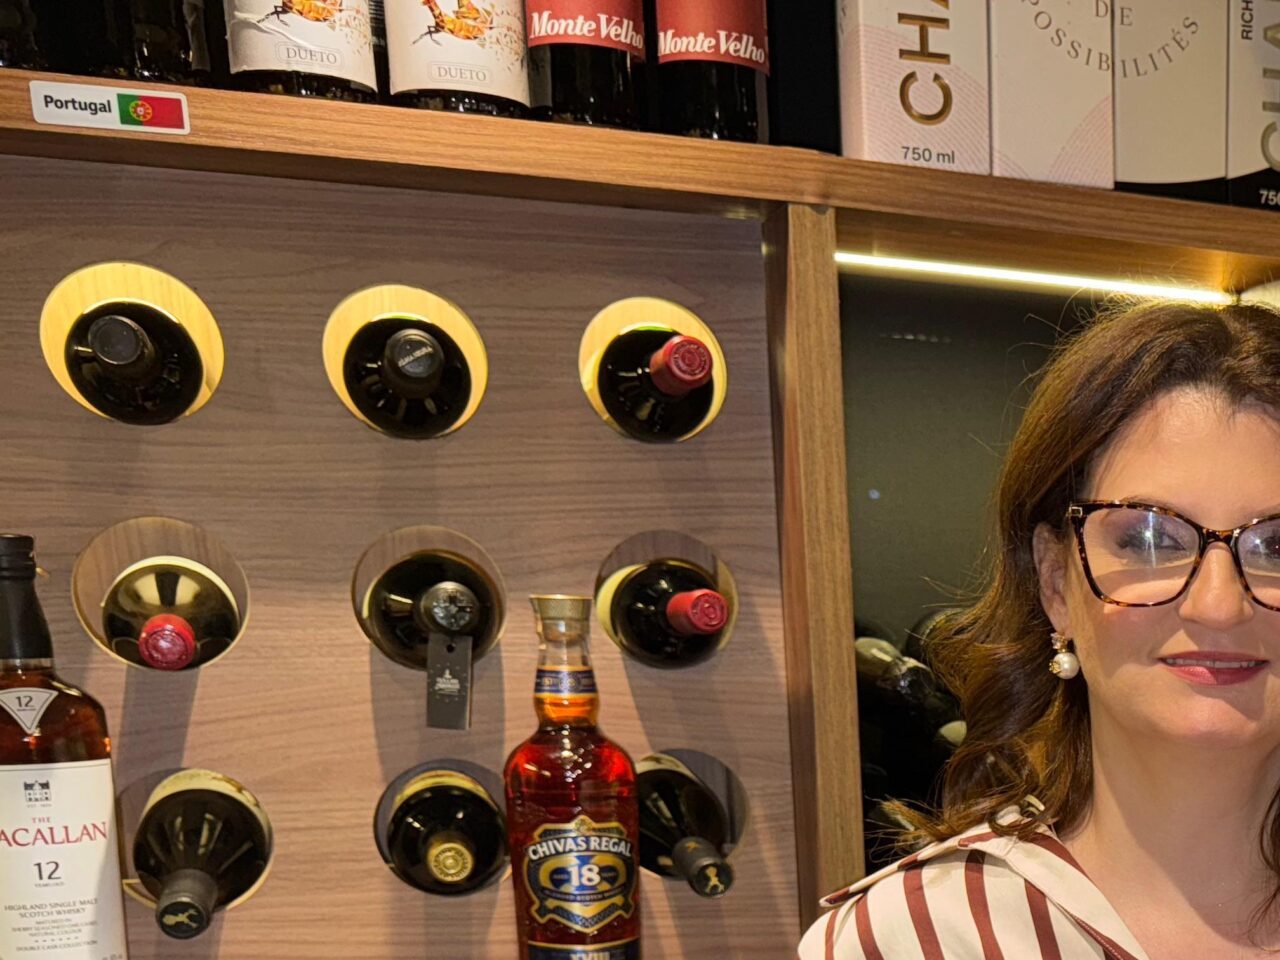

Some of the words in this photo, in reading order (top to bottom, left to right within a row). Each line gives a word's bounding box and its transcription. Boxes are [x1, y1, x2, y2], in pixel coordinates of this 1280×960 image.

[1094, 1, 1132, 27] DE
[530, 11, 597, 39] Monte
[597, 13, 644, 49] Velho
[1021, 0, 1200, 79] OSSIBILITÉS
[285, 47, 338, 65] DUETO
[657, 29, 716, 56] Monte
[716, 30, 765, 64] Velho
[436, 65, 488, 82] DUETO
[899, 0, 953, 126] CH
[43, 94, 112, 115] Portugal
[901, 146, 932, 163] 750
[936, 148, 956, 165] ml
[15, 694, 34, 709] 12
[32, 816, 52, 824] THE
[528, 836, 587, 860] CHIVAS
[588, 836, 632, 857] REGAL
[34, 861, 62, 881] 12
[567, 864, 602, 887] 18
